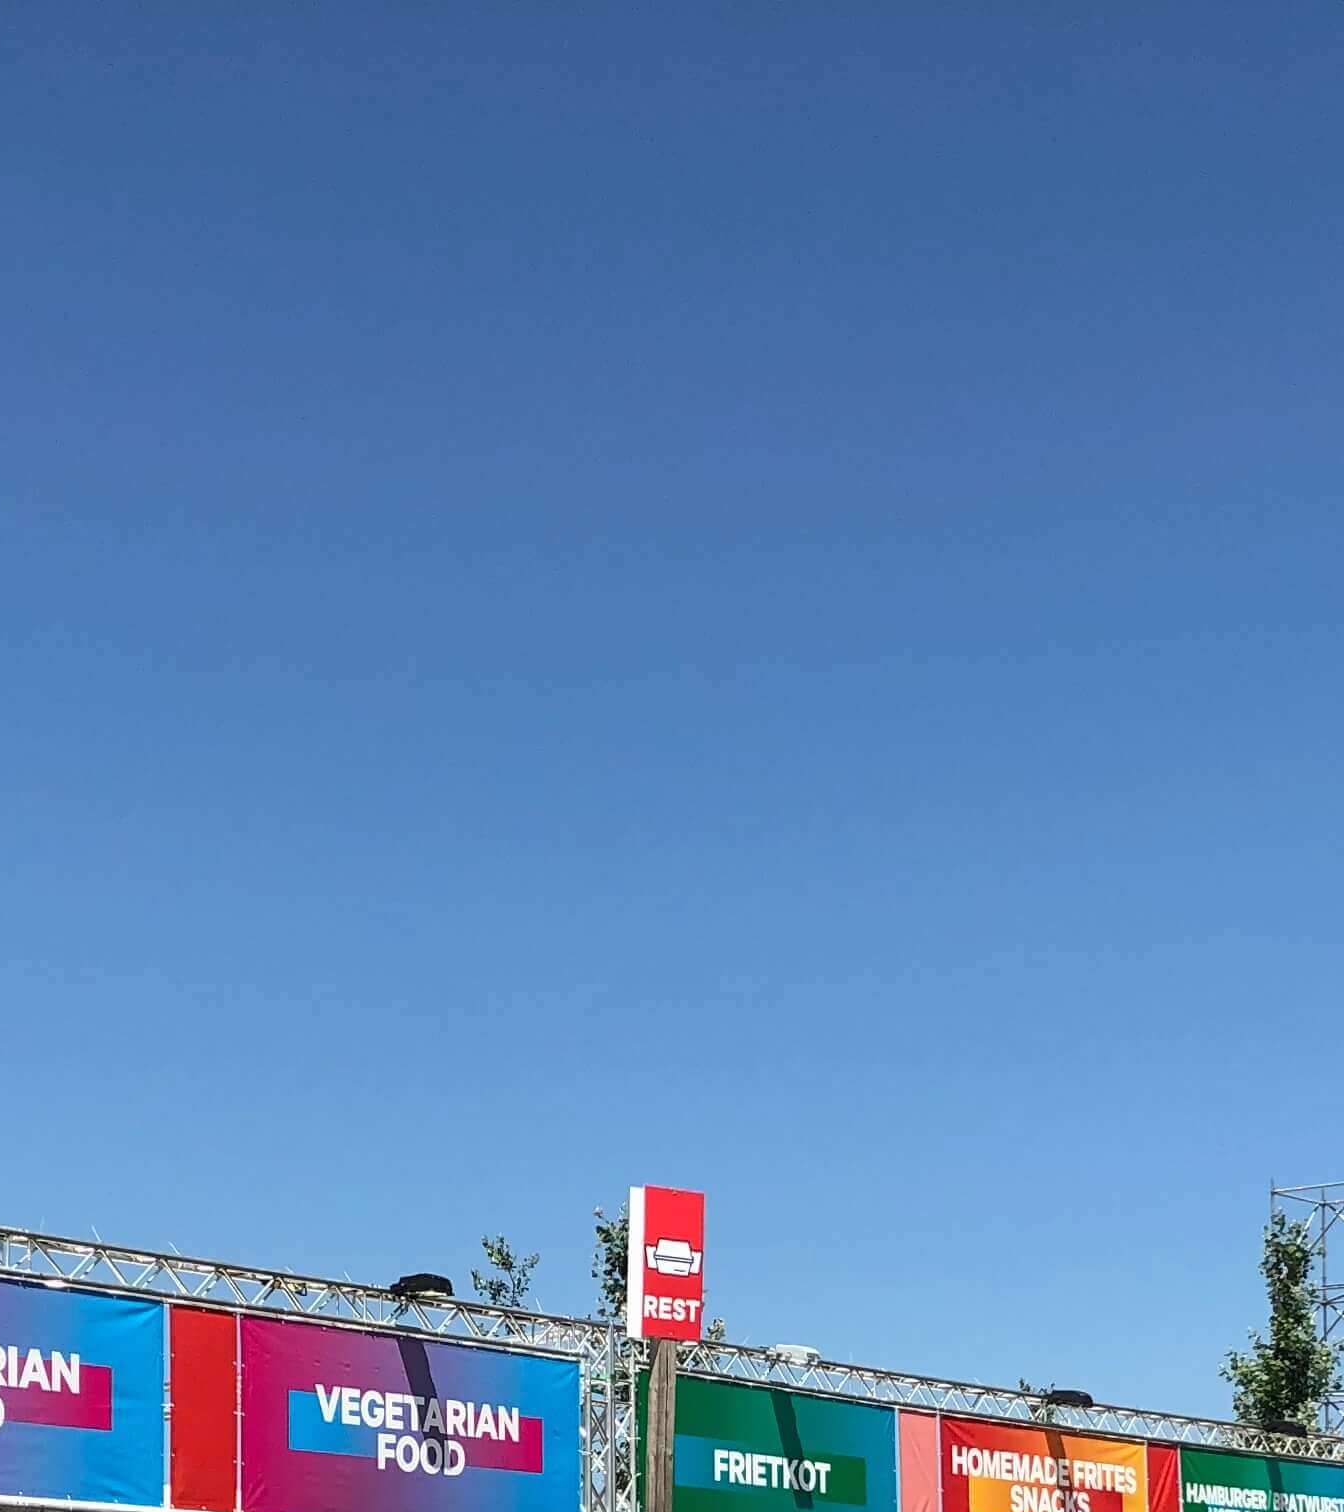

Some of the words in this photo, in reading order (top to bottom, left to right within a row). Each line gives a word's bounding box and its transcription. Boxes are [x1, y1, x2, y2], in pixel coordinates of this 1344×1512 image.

[643, 1294, 701, 1323] REST
[315, 1383, 520, 1443] VEGETARIAN
[377, 1433, 466, 1476] FOOD
[713, 1449, 832, 1494] FRIETKOT
[951, 1445, 1071, 1488] HOMEMADE
[1073, 1459, 1137, 1494] FRITES
[1186, 1482, 1267, 1510] HAMBURGER
